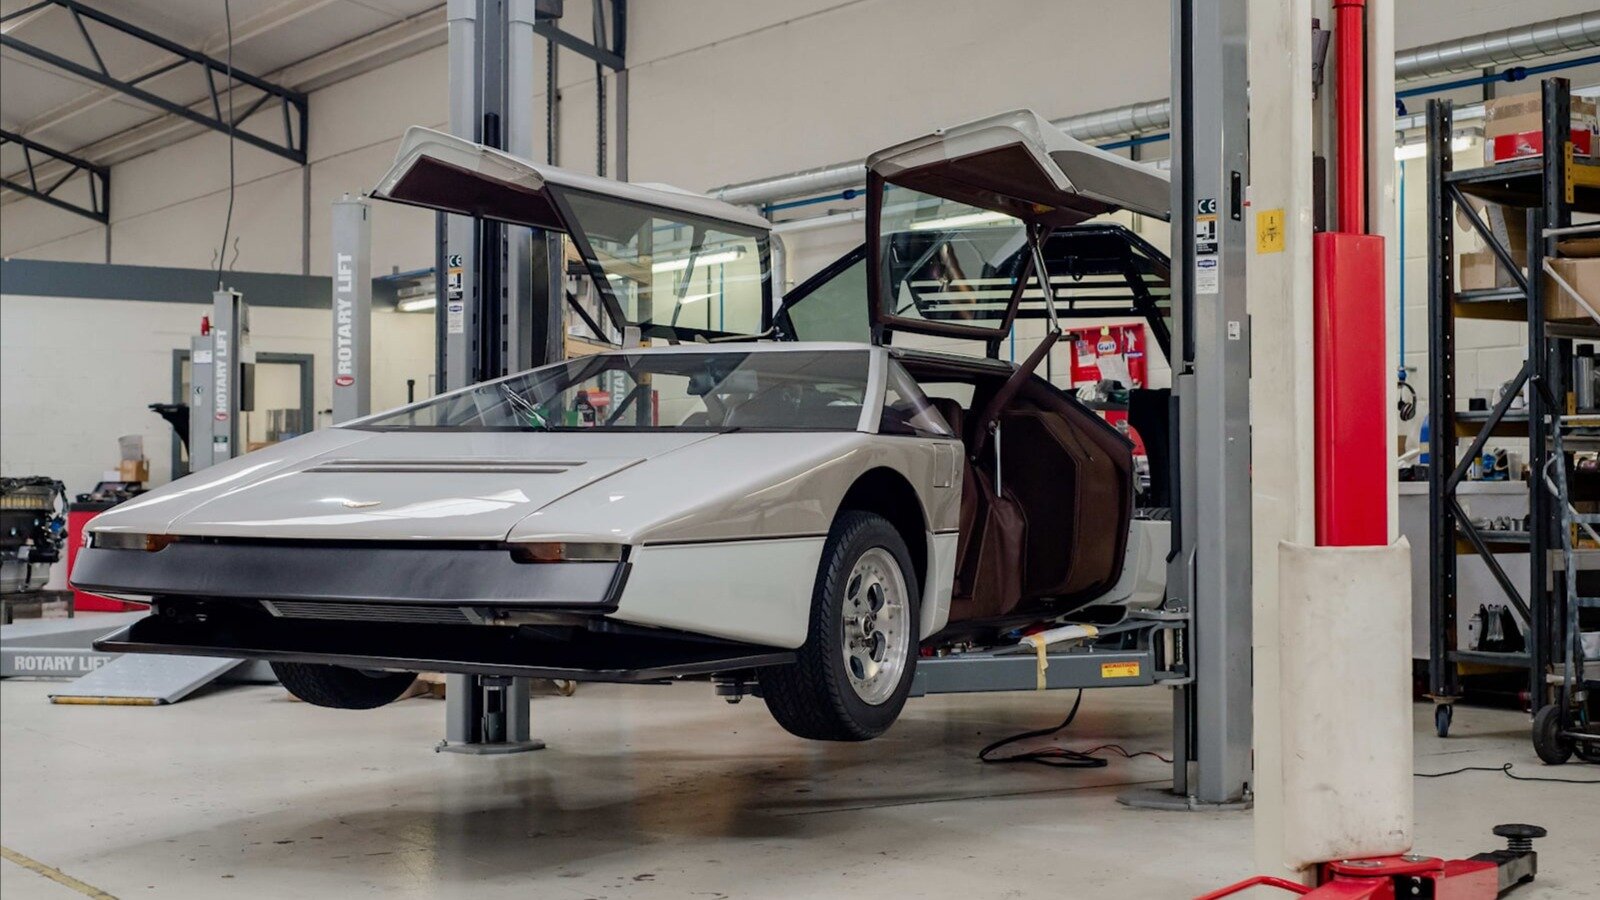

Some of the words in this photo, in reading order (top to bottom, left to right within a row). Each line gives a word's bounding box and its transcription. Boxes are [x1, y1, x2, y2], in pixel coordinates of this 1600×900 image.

[1198, 199, 1216, 213] CE
[337, 253, 352, 292] LIFT
[449, 255, 462, 267] CE
[216, 330, 227, 357] LIFT
[337, 298, 352, 375] ROTARY
[216, 360, 227, 412] ROTARY
[14, 656, 75, 671] ROTARY
